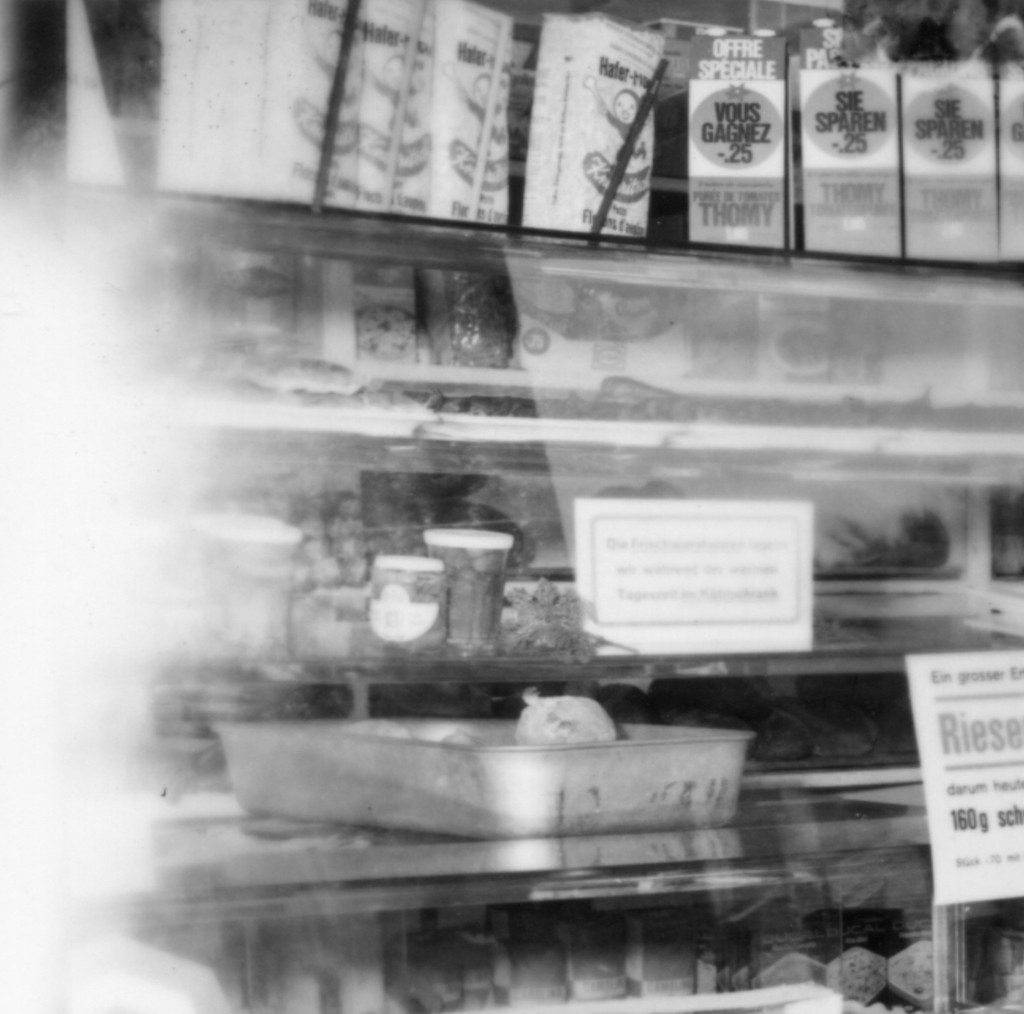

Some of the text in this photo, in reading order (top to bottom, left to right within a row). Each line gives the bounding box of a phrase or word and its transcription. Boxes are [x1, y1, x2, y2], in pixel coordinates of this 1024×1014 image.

[712, 38, 764, 58] OFFRE
[698, 57, 777, 80] SPÉCIALE
[835, 91, 865, 111] SIE
[933, 98, 962, 119] SIE
[713, 102, 761, 123] VOUS
[815, 111, 887, 133] SPAREN
[701, 123, 771, 144] GAGNEZ
[914, 119, 984, 140] SPAREN
[717, 143, 753, 164] -.25
[831, 132, 868, 154] -.25
[820, 182, 886, 204] THOMY
[698, 203, 774, 227] THOMY
[606, 536, 628, 551] Die
[930, 670, 952, 685] Ein
[957, 668, 1005, 686] grosser
[946, 780, 988, 797] darum
